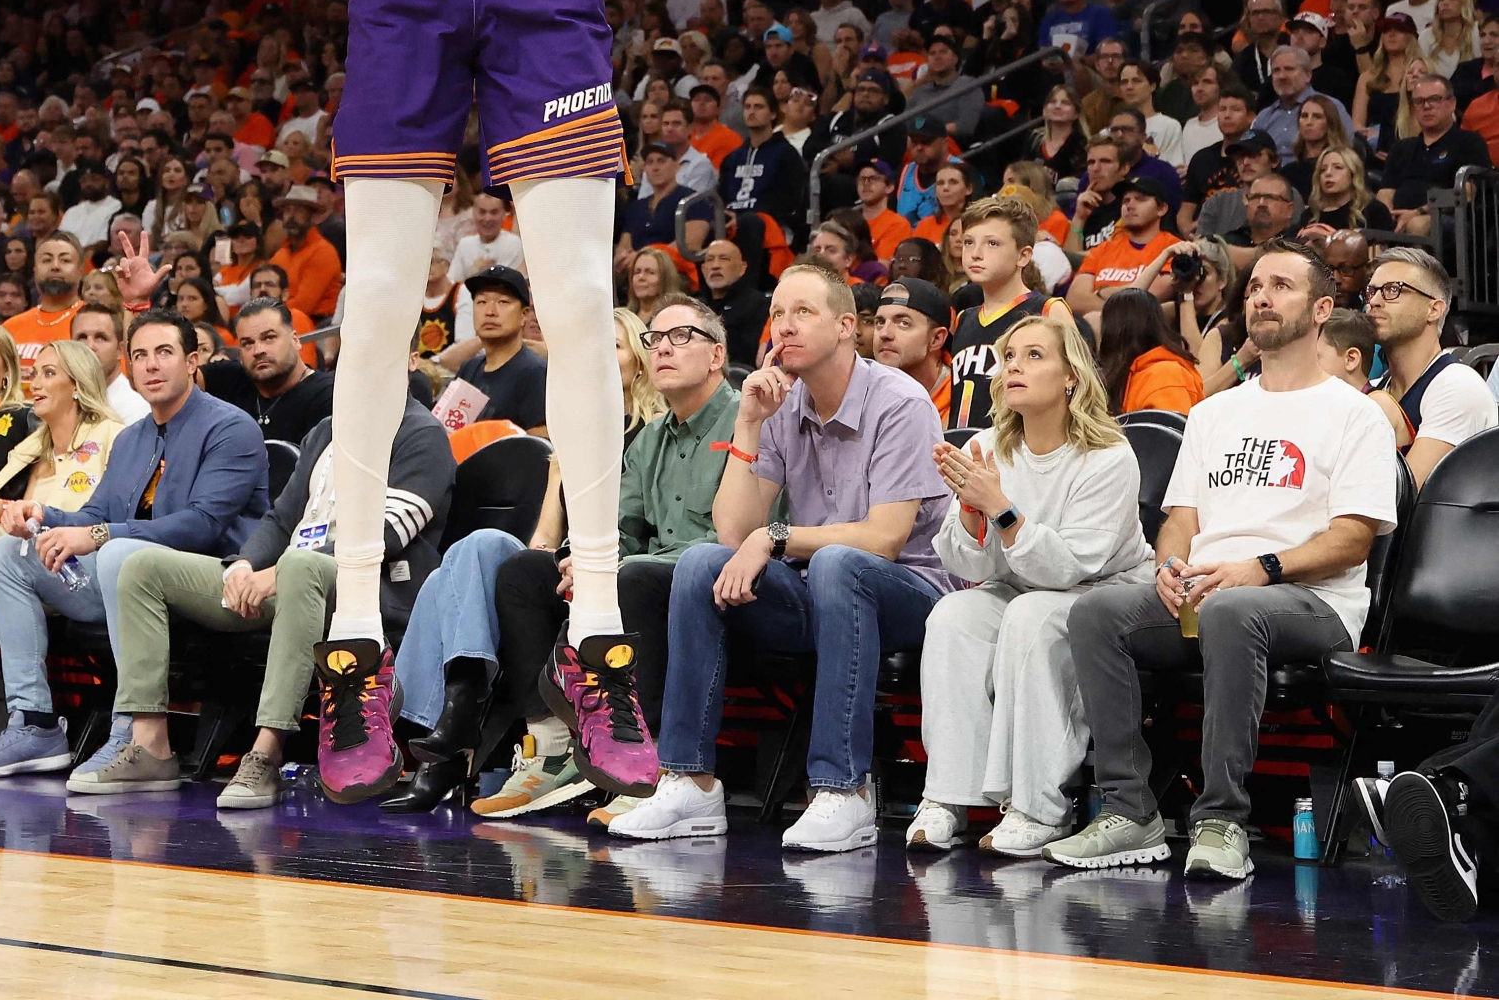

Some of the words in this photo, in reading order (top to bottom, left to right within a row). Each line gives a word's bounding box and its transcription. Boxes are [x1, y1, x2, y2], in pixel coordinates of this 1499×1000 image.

[1242, 437, 1278, 454] THE
[1224, 452, 1273, 471] TRUE
[1208, 467, 1269, 489] NORTH
